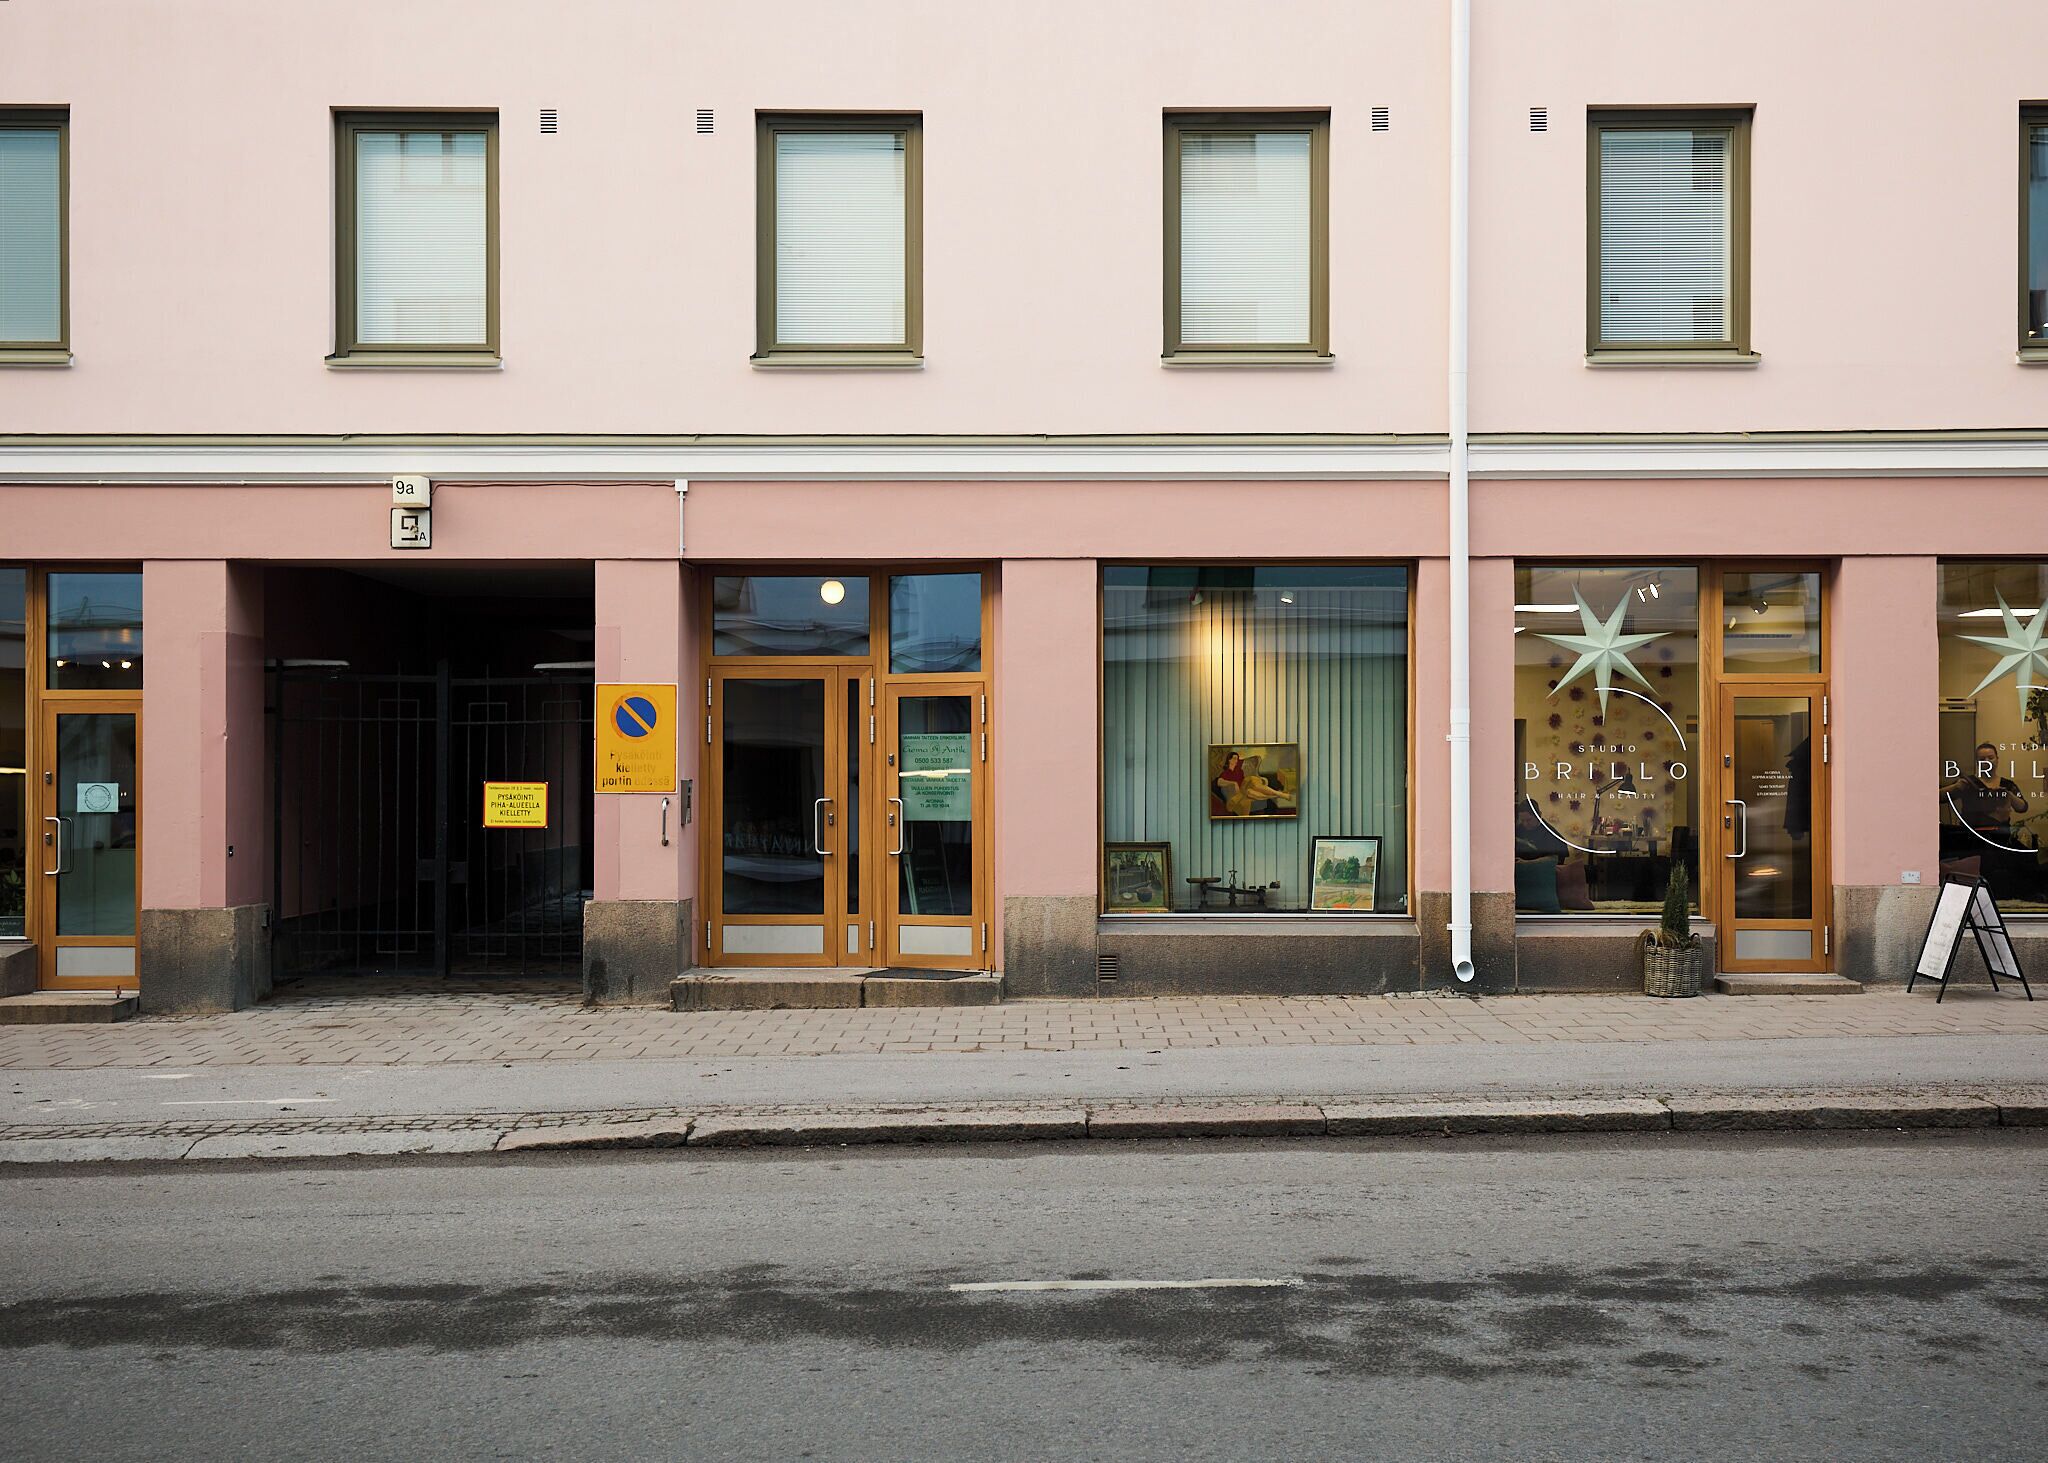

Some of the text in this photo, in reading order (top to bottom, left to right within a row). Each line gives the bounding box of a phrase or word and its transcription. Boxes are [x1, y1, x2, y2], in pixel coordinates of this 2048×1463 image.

[396, 480, 415, 494] 9a
[1578, 745, 1637, 753] STUDIO
[1524, 762, 1688, 780] BRILLO
[602, 775, 632, 788] portin
[490, 801, 540, 809] PIHA-ALUEELLA
[499, 809, 531, 817] KIELLETTY
